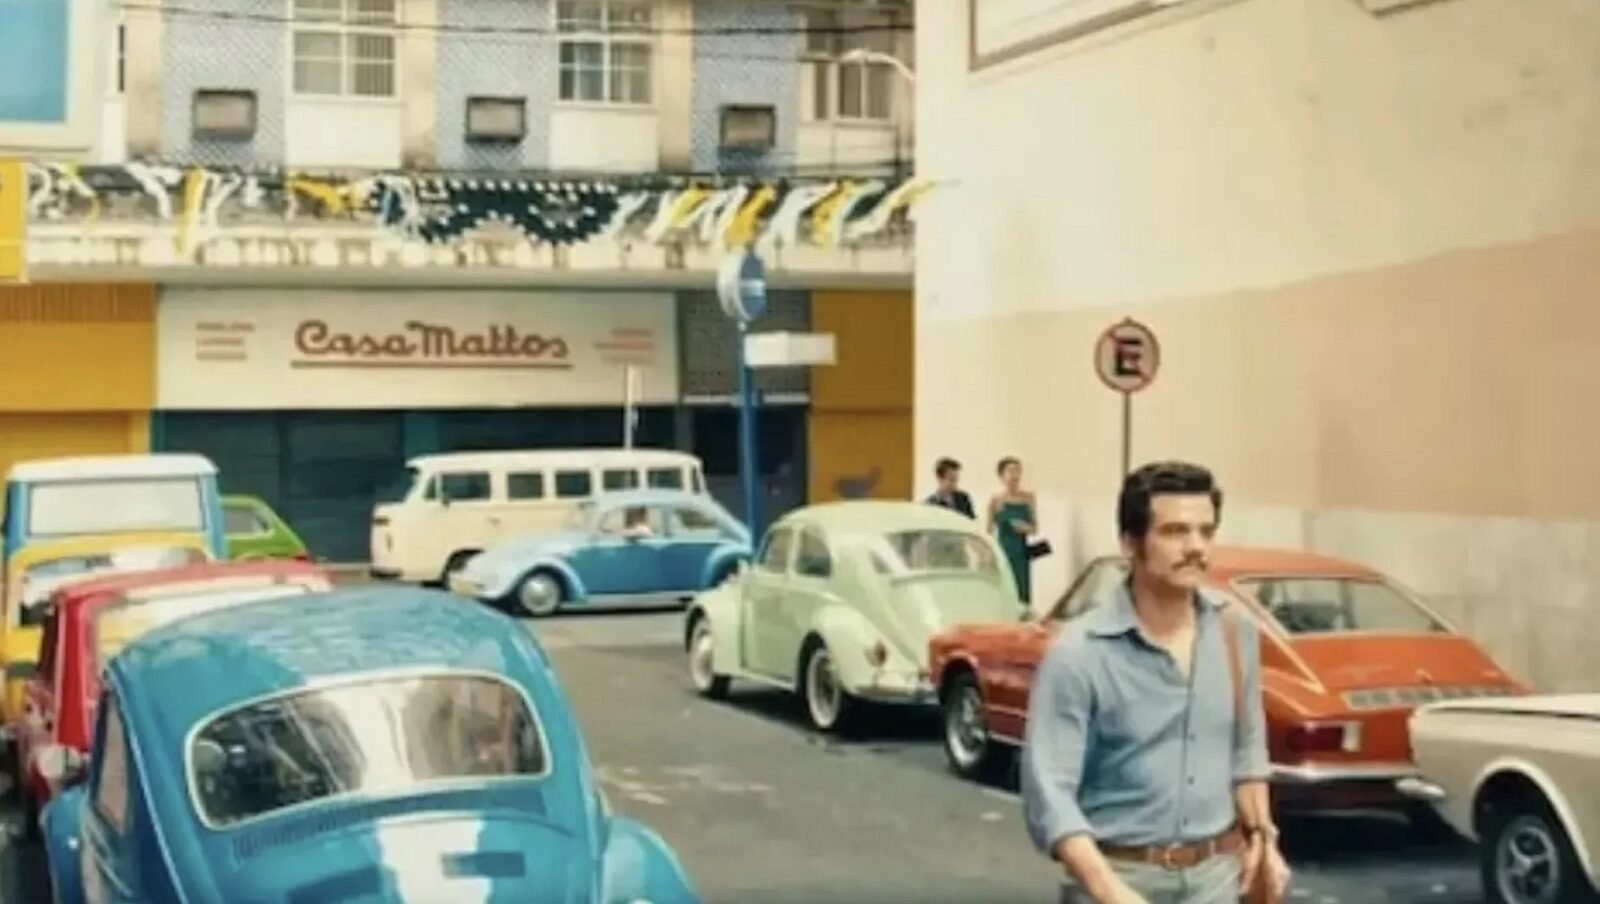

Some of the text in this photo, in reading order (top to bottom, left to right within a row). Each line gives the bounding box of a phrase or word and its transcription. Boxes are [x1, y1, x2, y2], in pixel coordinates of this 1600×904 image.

[295, 319, 568, 358] Casa Mattos
[1115, 338, 1142, 376] E
